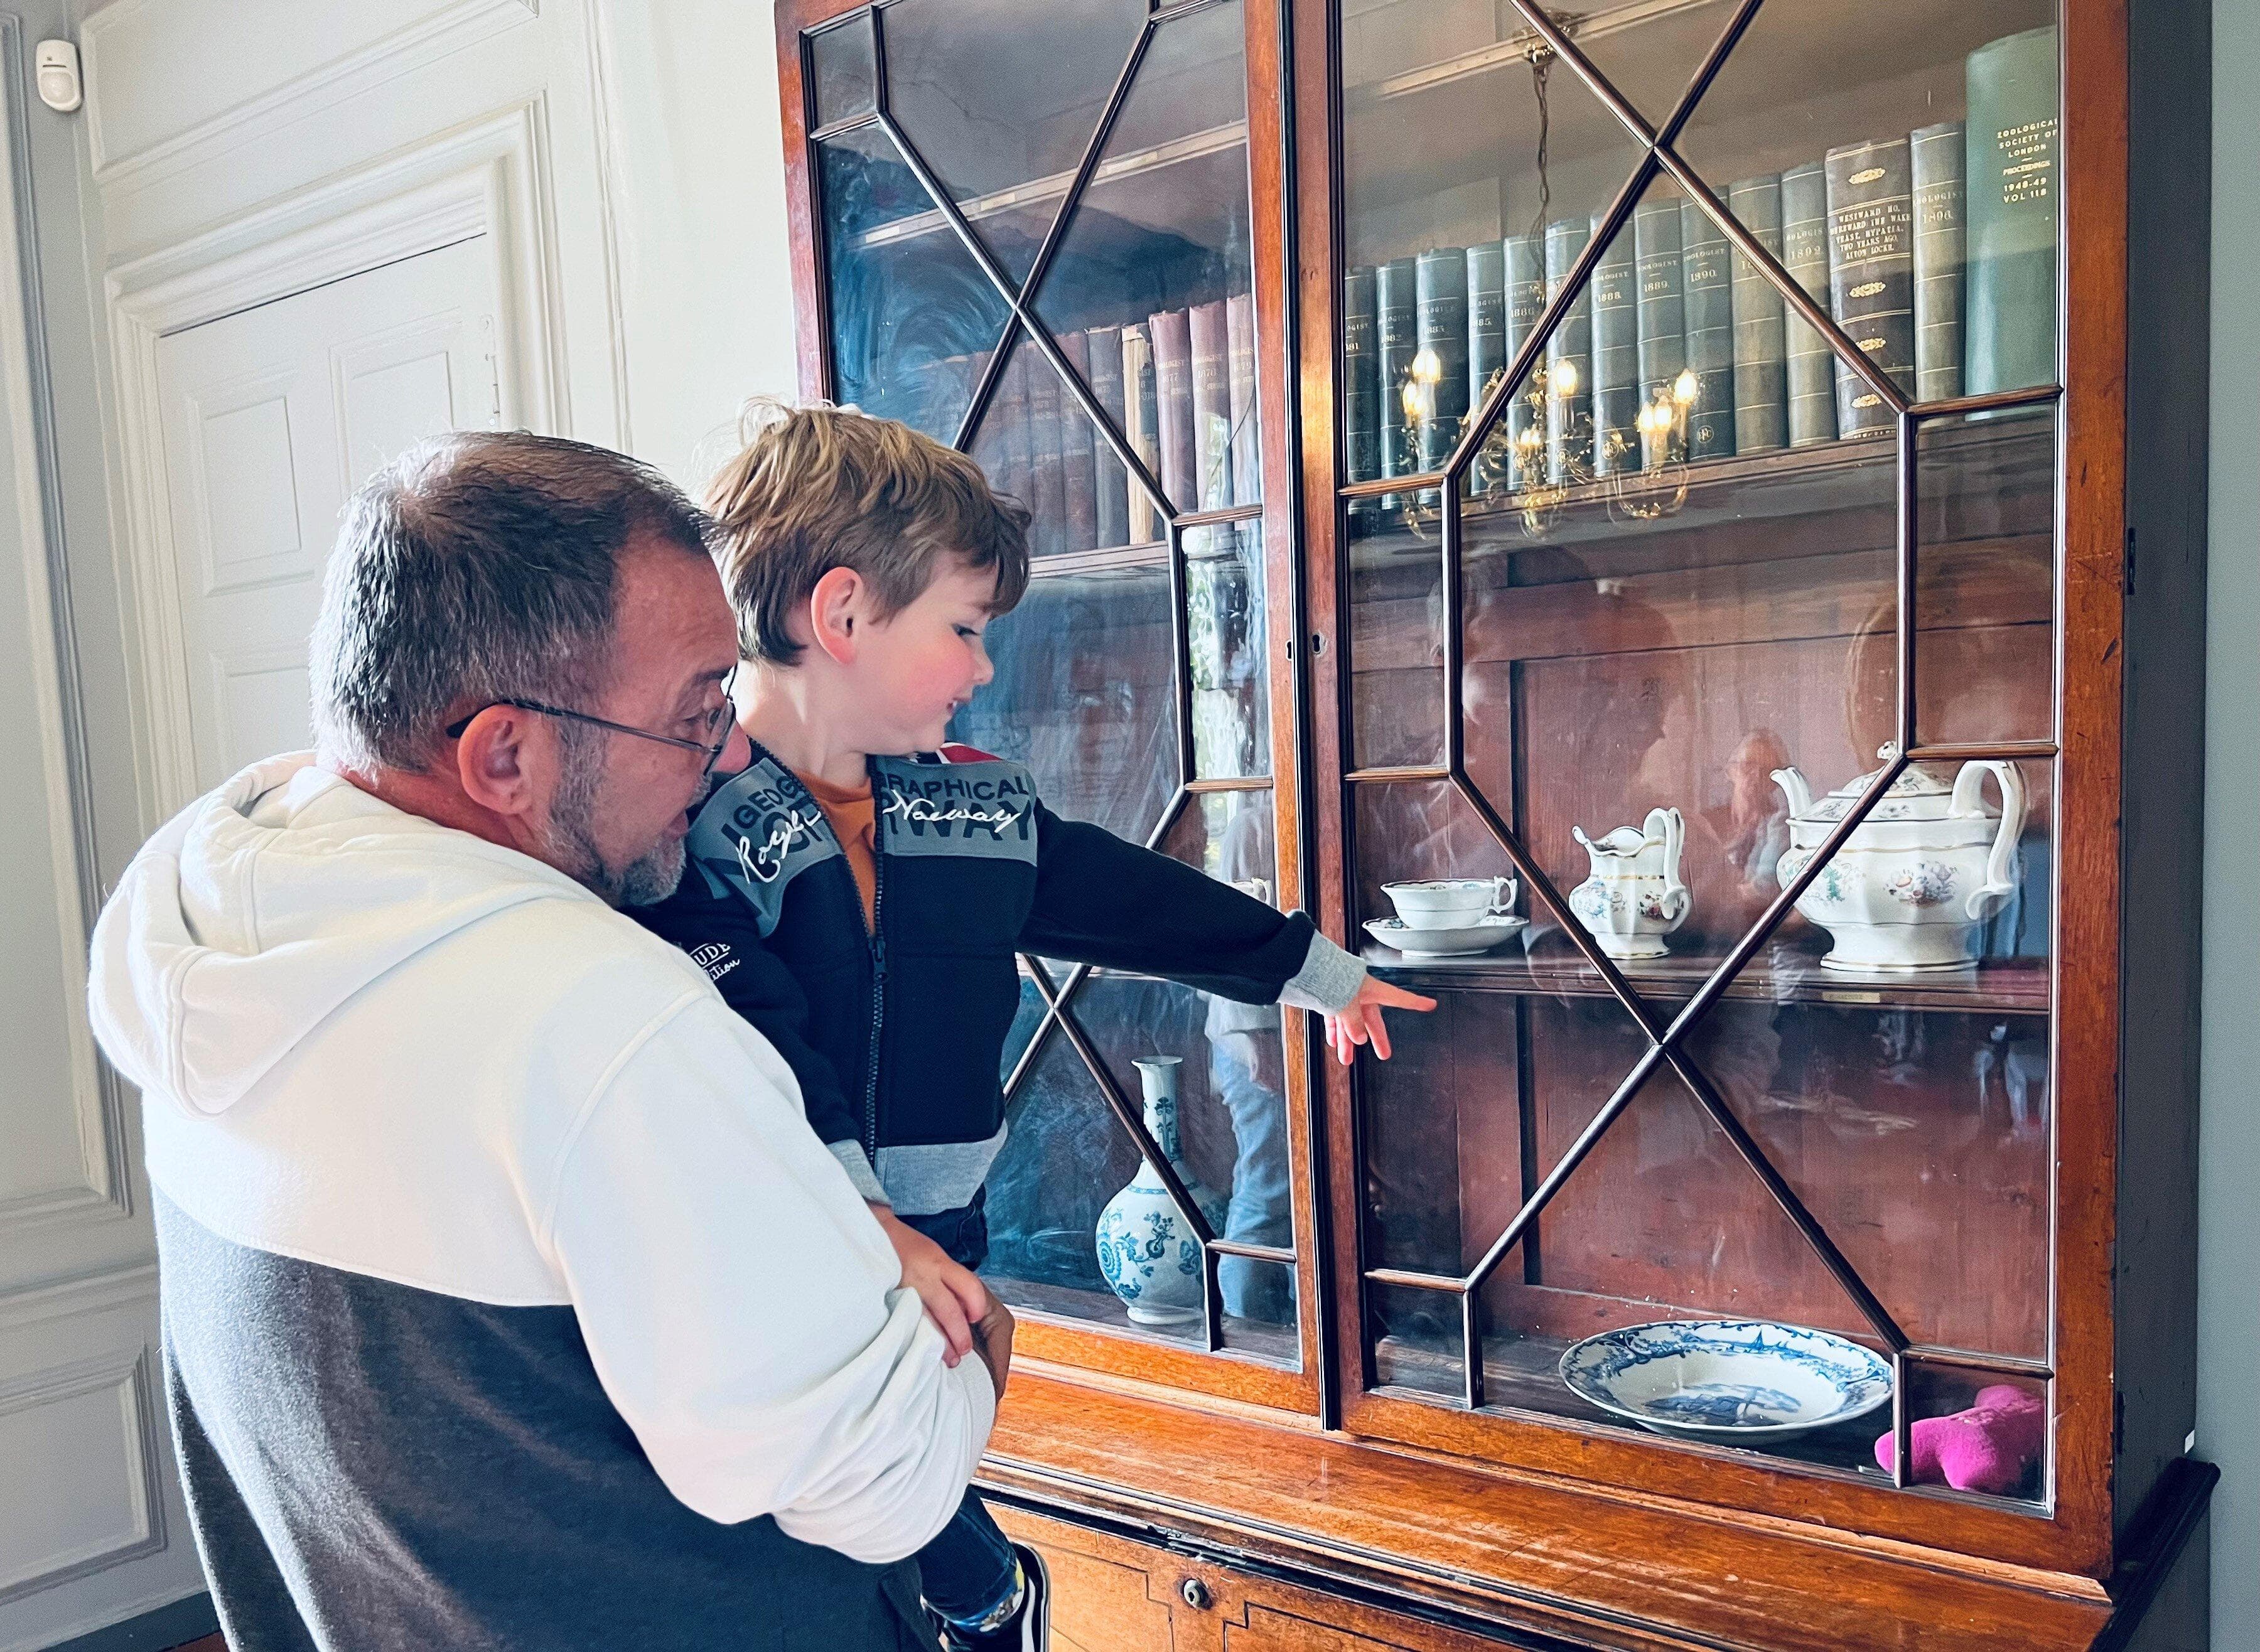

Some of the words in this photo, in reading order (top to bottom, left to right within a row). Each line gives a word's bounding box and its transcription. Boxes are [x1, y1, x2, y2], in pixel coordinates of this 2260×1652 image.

[1999, 133, 2040, 149] SOCIETY
[2008, 144, 2047, 158] LONDON
[2003, 159, 2051, 176] PROCEEDINGS
[2003, 193, 2026, 203] VOL
[1839, 208, 1881, 223] WESTWARD
[1871, 217, 1885, 227] THE
[1857, 237, 1880, 249] YEARS
[734, 775, 800, 829] GEOG
